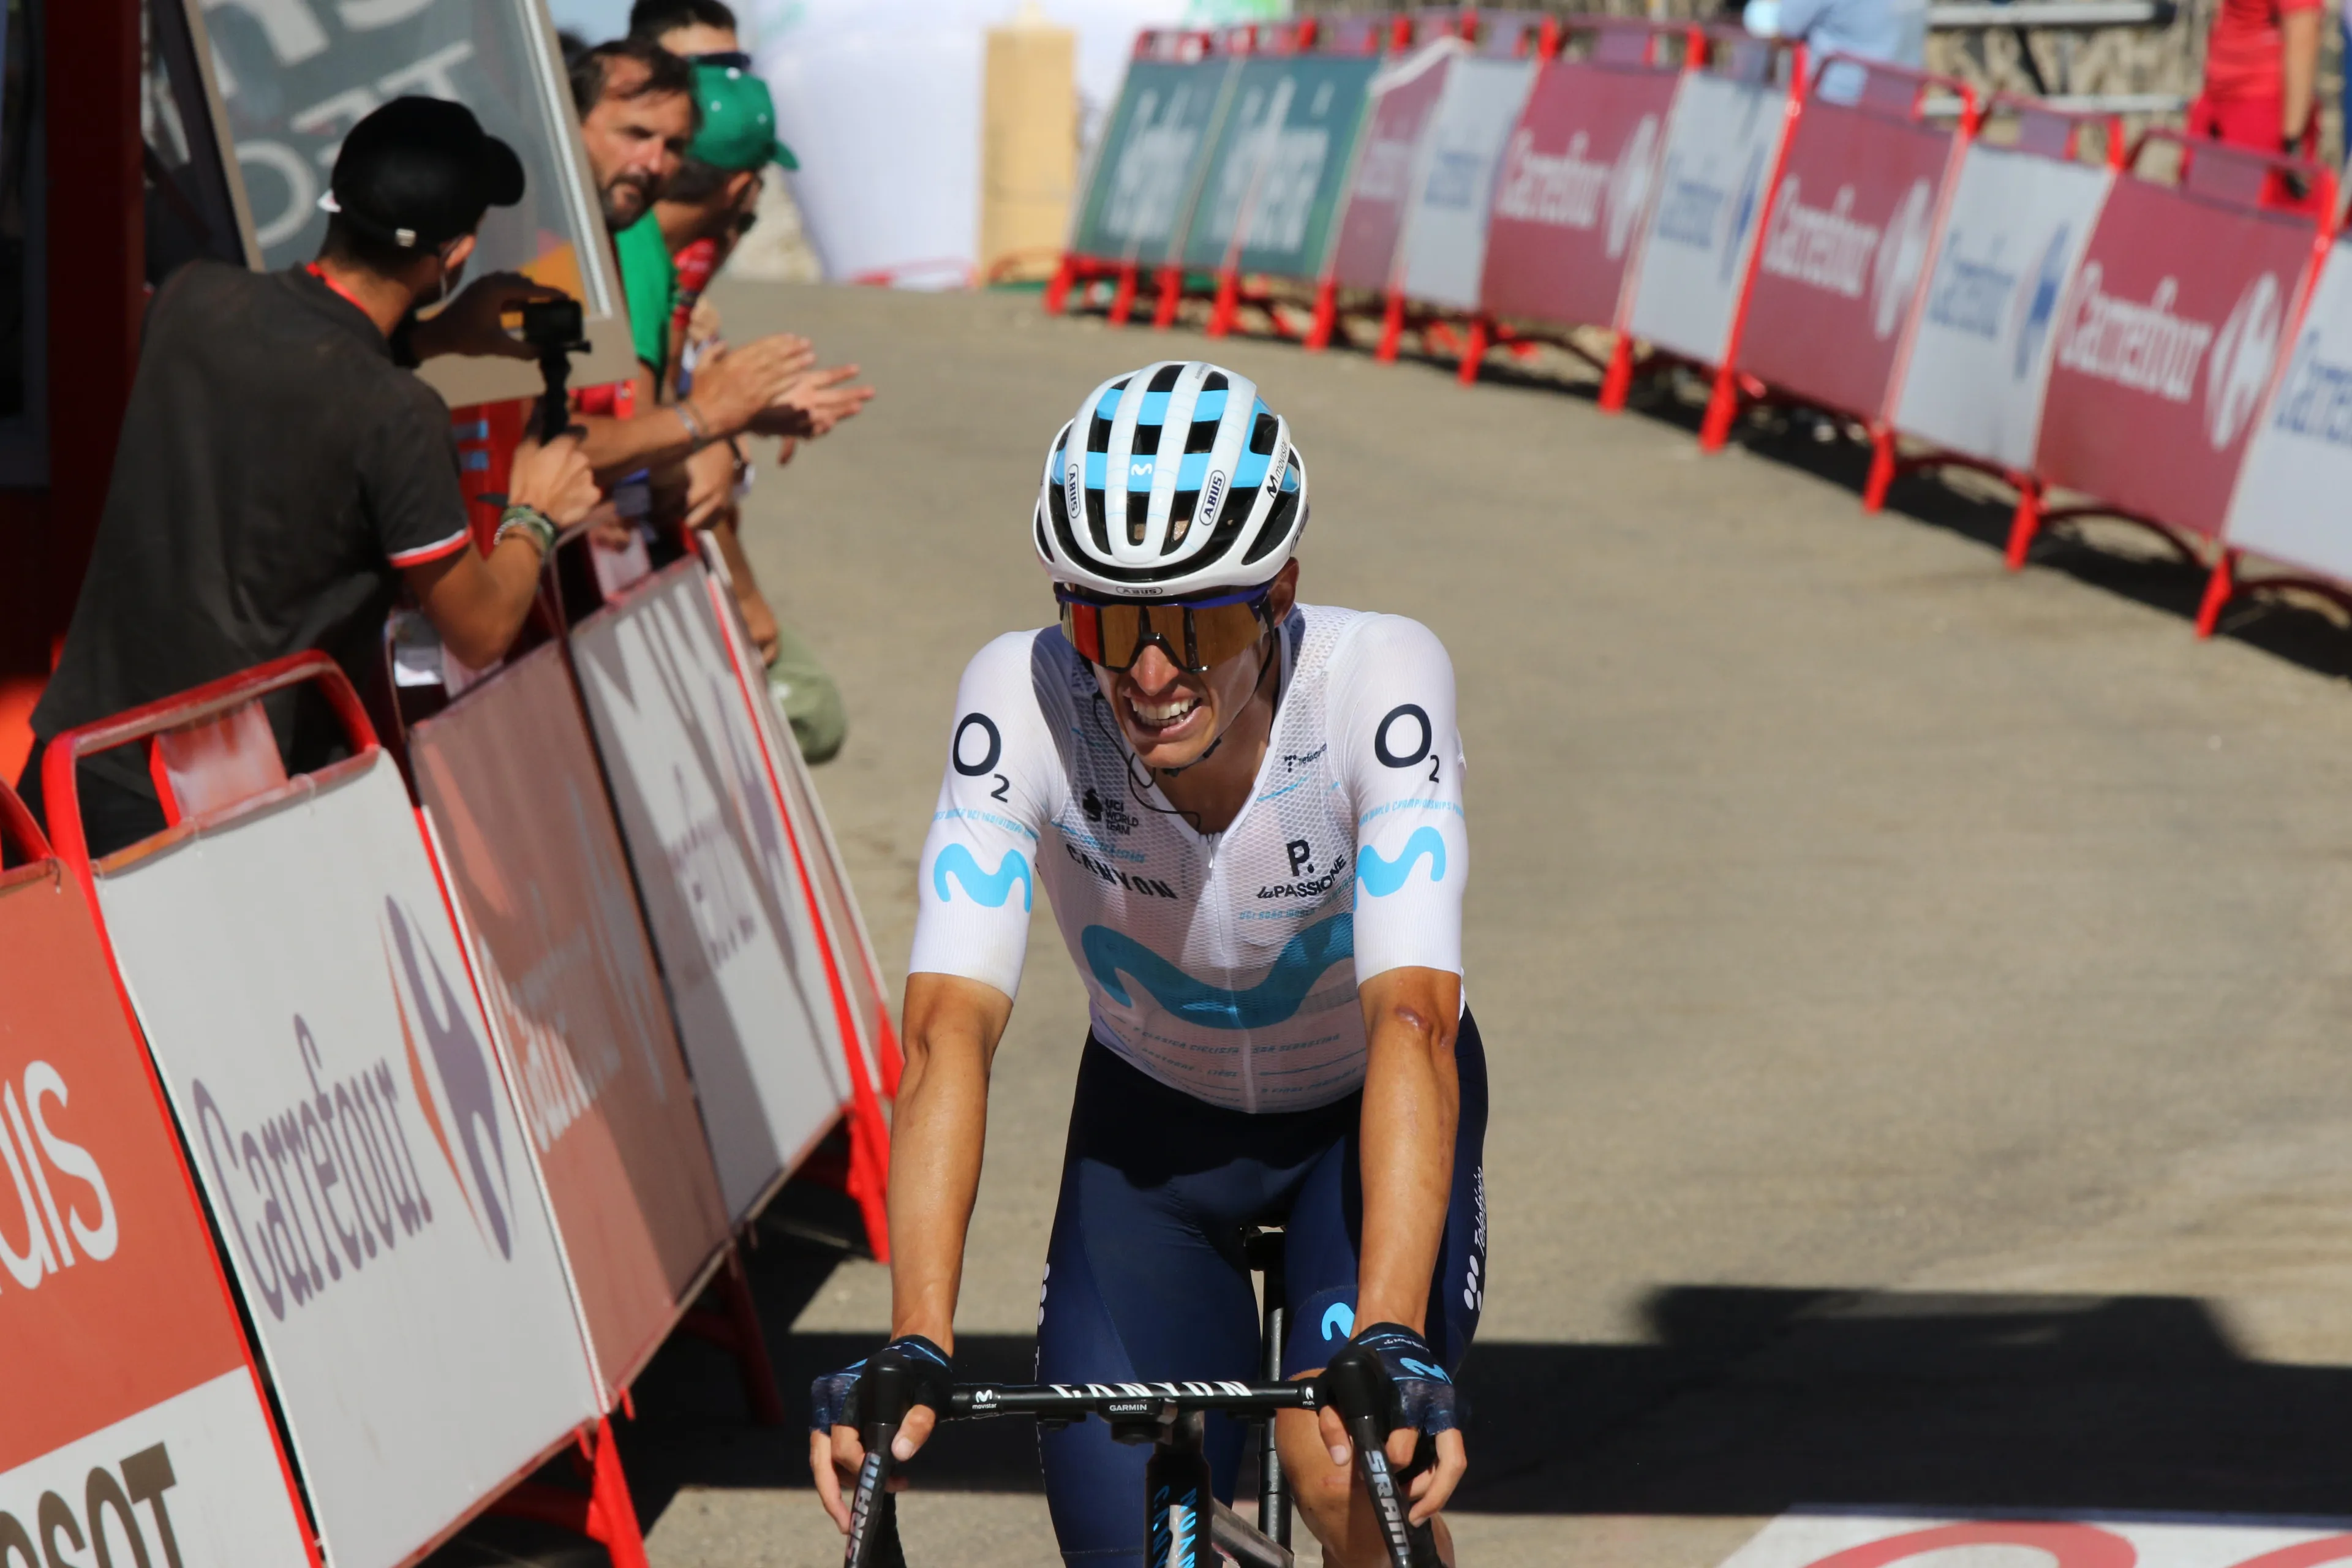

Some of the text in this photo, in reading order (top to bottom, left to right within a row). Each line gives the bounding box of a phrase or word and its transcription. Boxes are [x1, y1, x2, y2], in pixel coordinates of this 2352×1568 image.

[1069, 472, 1078, 512] ABUS
[1204, 475, 1223, 519] ABUS
[1122, 587, 1156, 595] ABUS
[1105, 799, 1124, 812] UCI
[1106, 810, 1139, 827] WORLD
[1106, 819, 1131, 835] TEAM
[1066, 843, 1178, 899] CANYON
[192, 1013, 433, 1323] Carrefour
[846, 1452, 881, 1562] SRAM
[1365, 1450, 1411, 1556] SRAM
